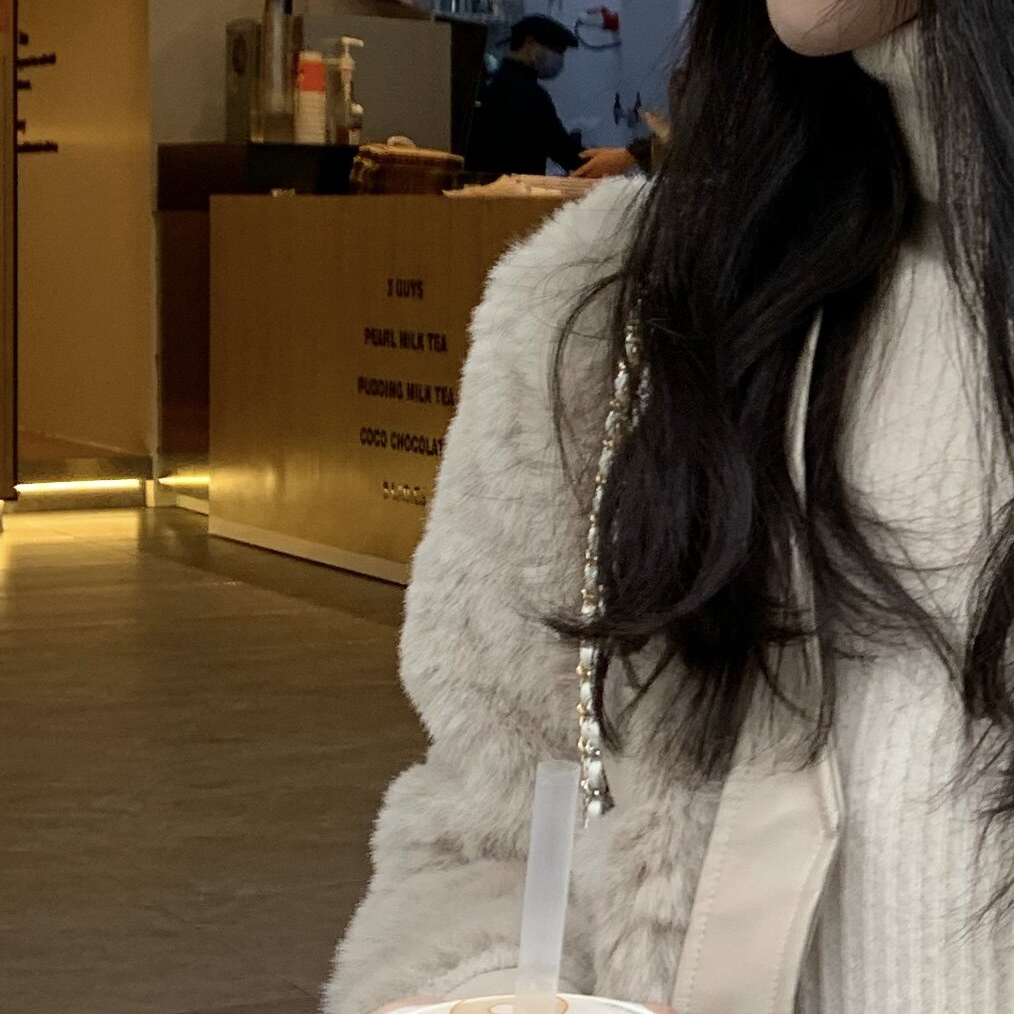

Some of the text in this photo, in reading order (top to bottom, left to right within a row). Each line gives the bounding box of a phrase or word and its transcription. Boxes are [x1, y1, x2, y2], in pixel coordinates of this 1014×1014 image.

[364, 326, 447, 352] PEARL MILK TEA
[357, 376, 455, 406] PUDDING MILK TEA
[359, 426, 445, 456] COCO CHOCOLAT
